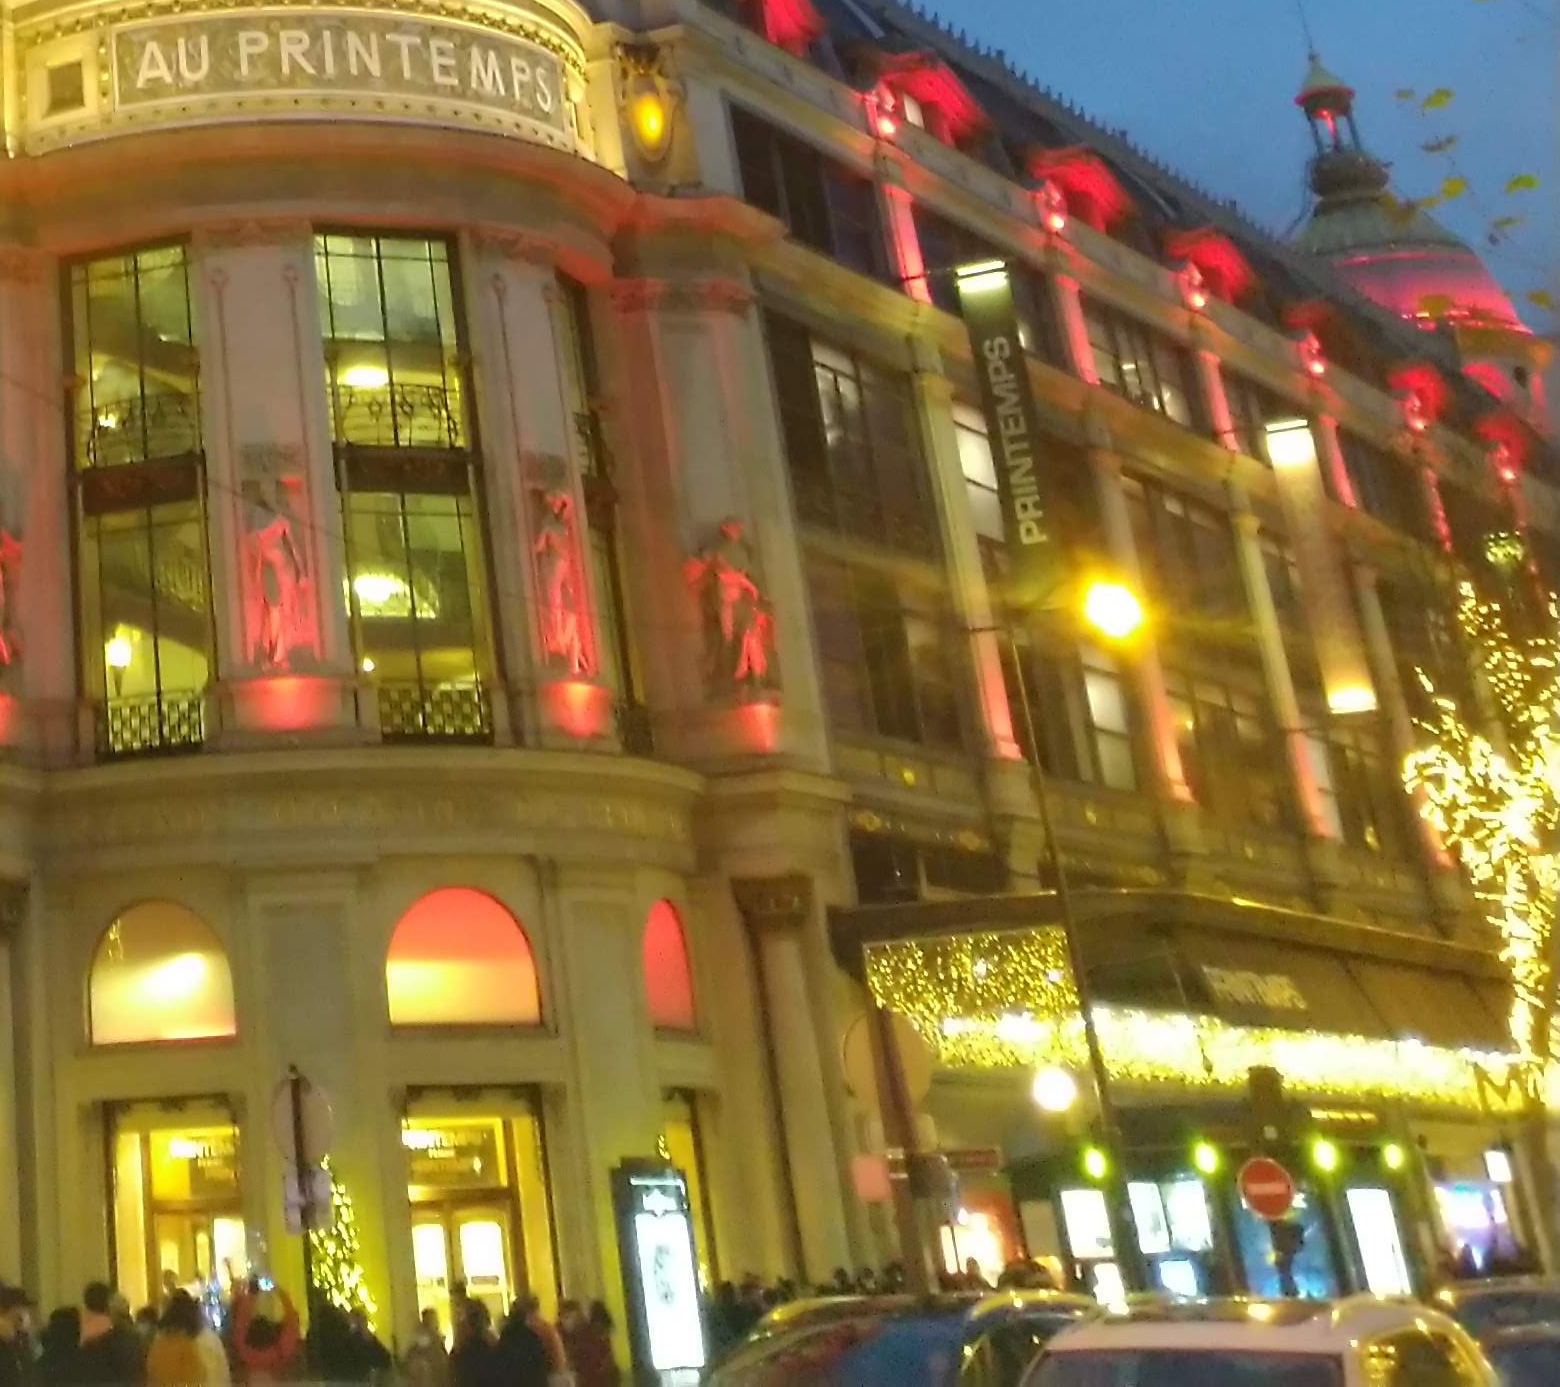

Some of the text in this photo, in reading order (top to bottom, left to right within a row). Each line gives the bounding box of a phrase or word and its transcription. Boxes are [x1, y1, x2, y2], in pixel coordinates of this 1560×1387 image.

[137, 29, 557, 114] AU PRINTEMPS
[983, 336, 1048, 545] PRINTEMPS
